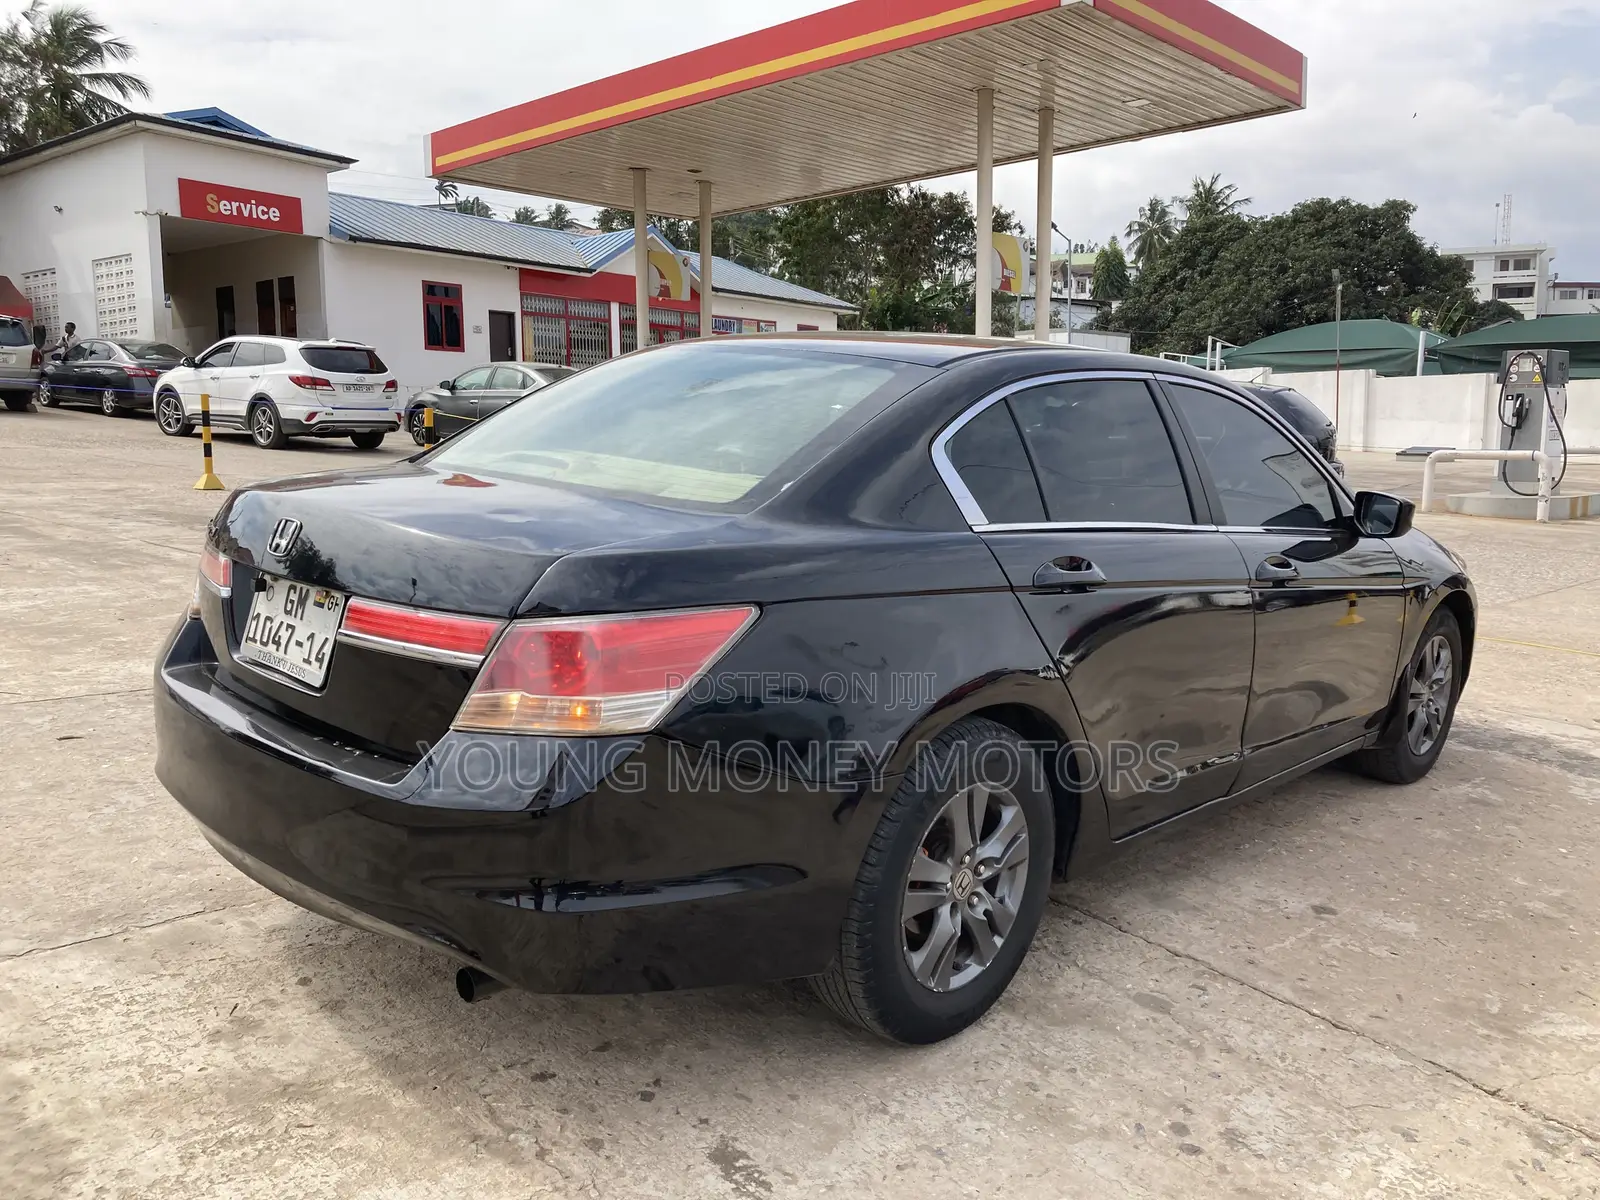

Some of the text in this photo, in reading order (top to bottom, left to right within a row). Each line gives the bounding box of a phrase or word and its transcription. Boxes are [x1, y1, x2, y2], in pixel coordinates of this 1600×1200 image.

[205, 192, 281, 222] Service
[712, 318, 736, 332] LAUNDRY
[284, 583, 310, 621] GM
[247, 612, 330, 669] 1047-14
[287, 663, 307, 679] JESUS
